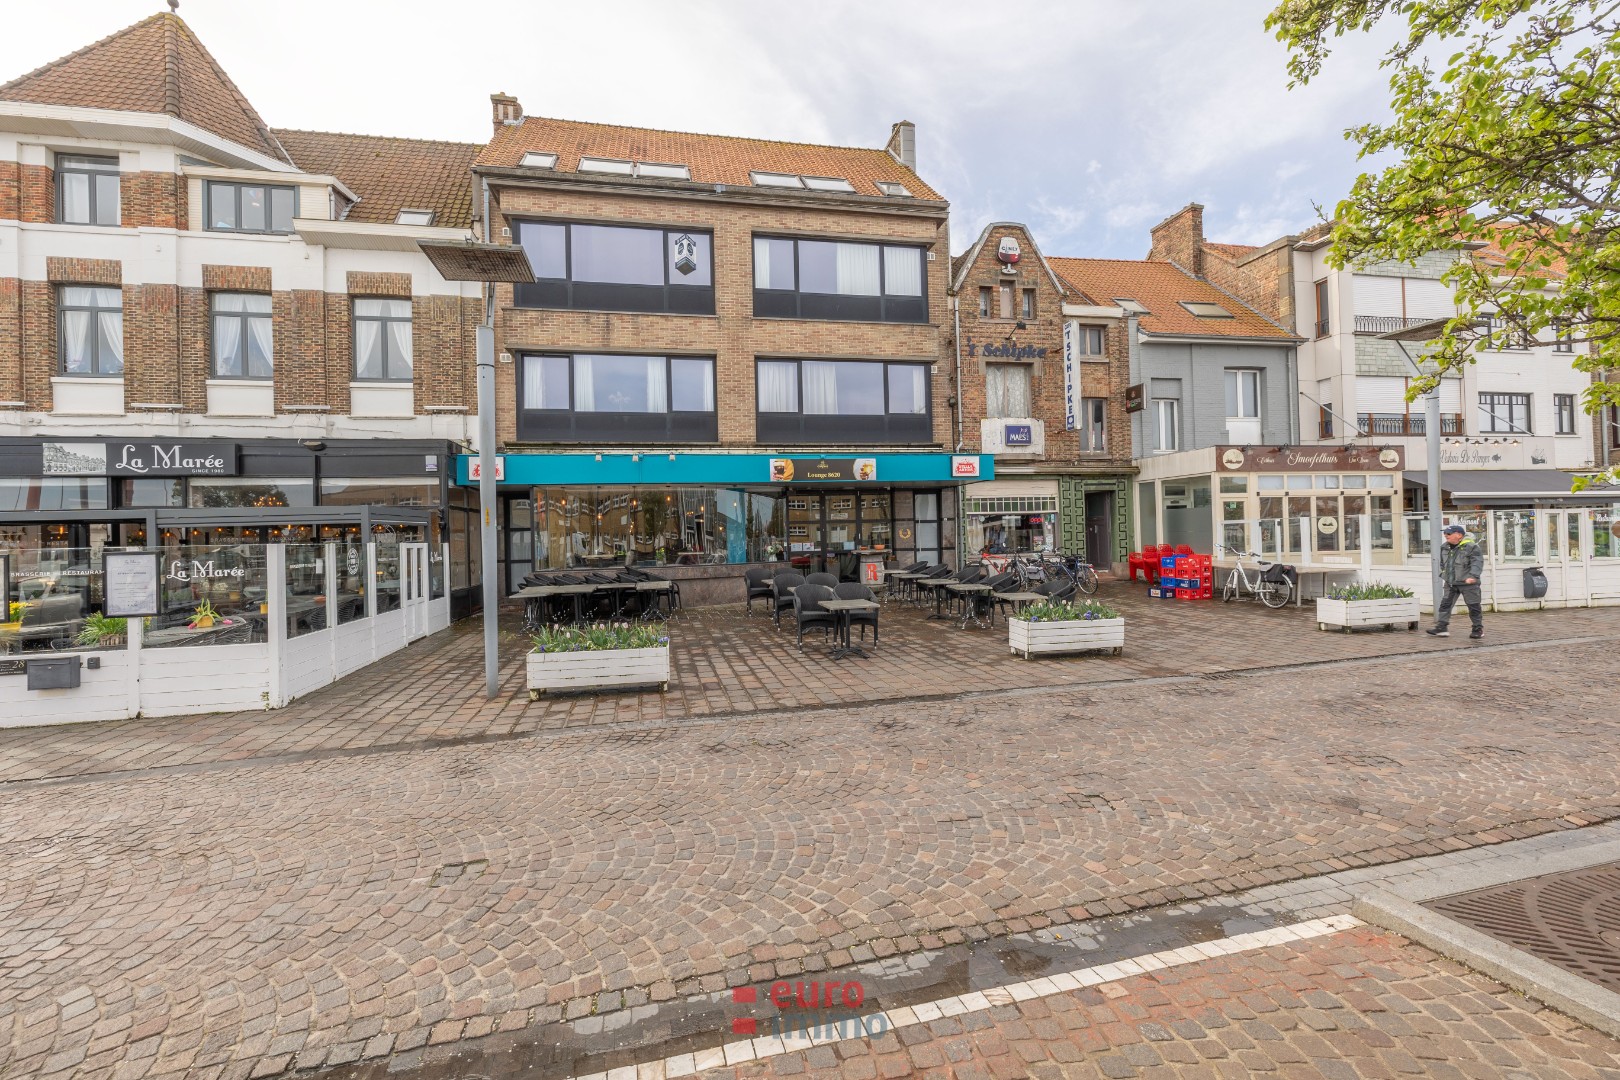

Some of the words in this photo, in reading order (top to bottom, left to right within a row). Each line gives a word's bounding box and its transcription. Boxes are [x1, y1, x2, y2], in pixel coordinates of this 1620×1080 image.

[982, 341, 1048, 361] Schipke
[115, 444, 149, 473] La
[151, 445, 224, 469] Marée
[166, 561, 191, 582] La
[192, 560, 245, 578] Marée
[866, 563, 879, 581] R
[12, 660, 25, 669] 28
